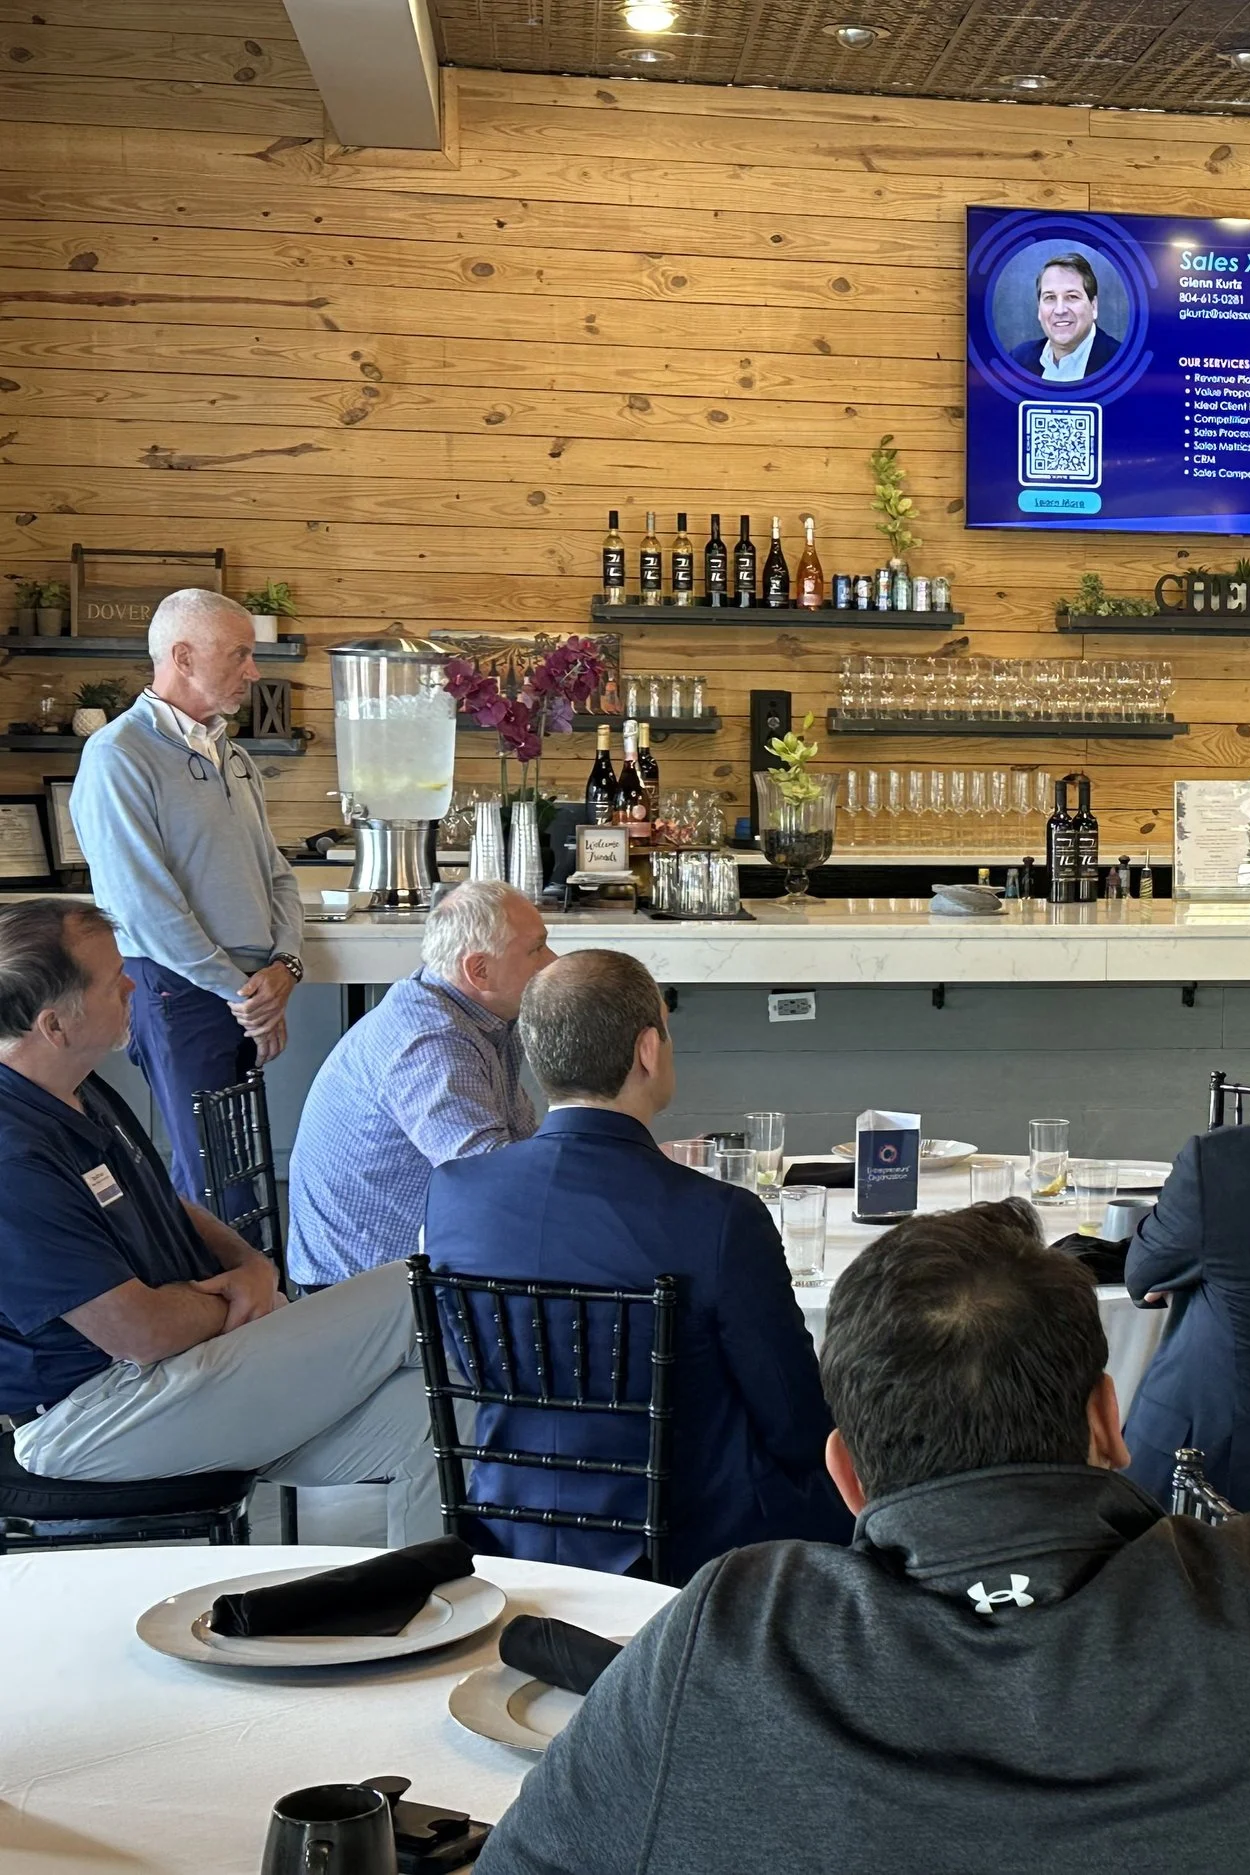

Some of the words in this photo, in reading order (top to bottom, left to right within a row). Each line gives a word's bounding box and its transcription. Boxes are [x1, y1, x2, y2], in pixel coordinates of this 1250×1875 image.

[1180, 251, 1239, 273] Sales
[1179, 277, 1213, 288] Glenn
[1216, 278, 1242, 290] Kurtz
[1179, 293, 1244, 305] 804-615-0281
[1179, 357, 1200, 367] OUR
[1203, 358, 1250, 369] SERVICES
[1194, 373, 1235, 384] Revenue
[1194, 387, 1221, 397] Value
[1194, 401, 1218, 410] Ideal
[1220, 401, 1247, 411] Client
[1194, 428, 1217, 437] Sales
[1193, 441, 1217, 451] Sales
[1193, 454, 1216, 464] CRM
[1193, 468, 1216, 478] Sales
[1034, 498, 1060, 508] Learn
[1061, 498, 1085, 509] More
[88, 603, 151, 620] DOVER
[585, 838, 619, 850] Welcome
